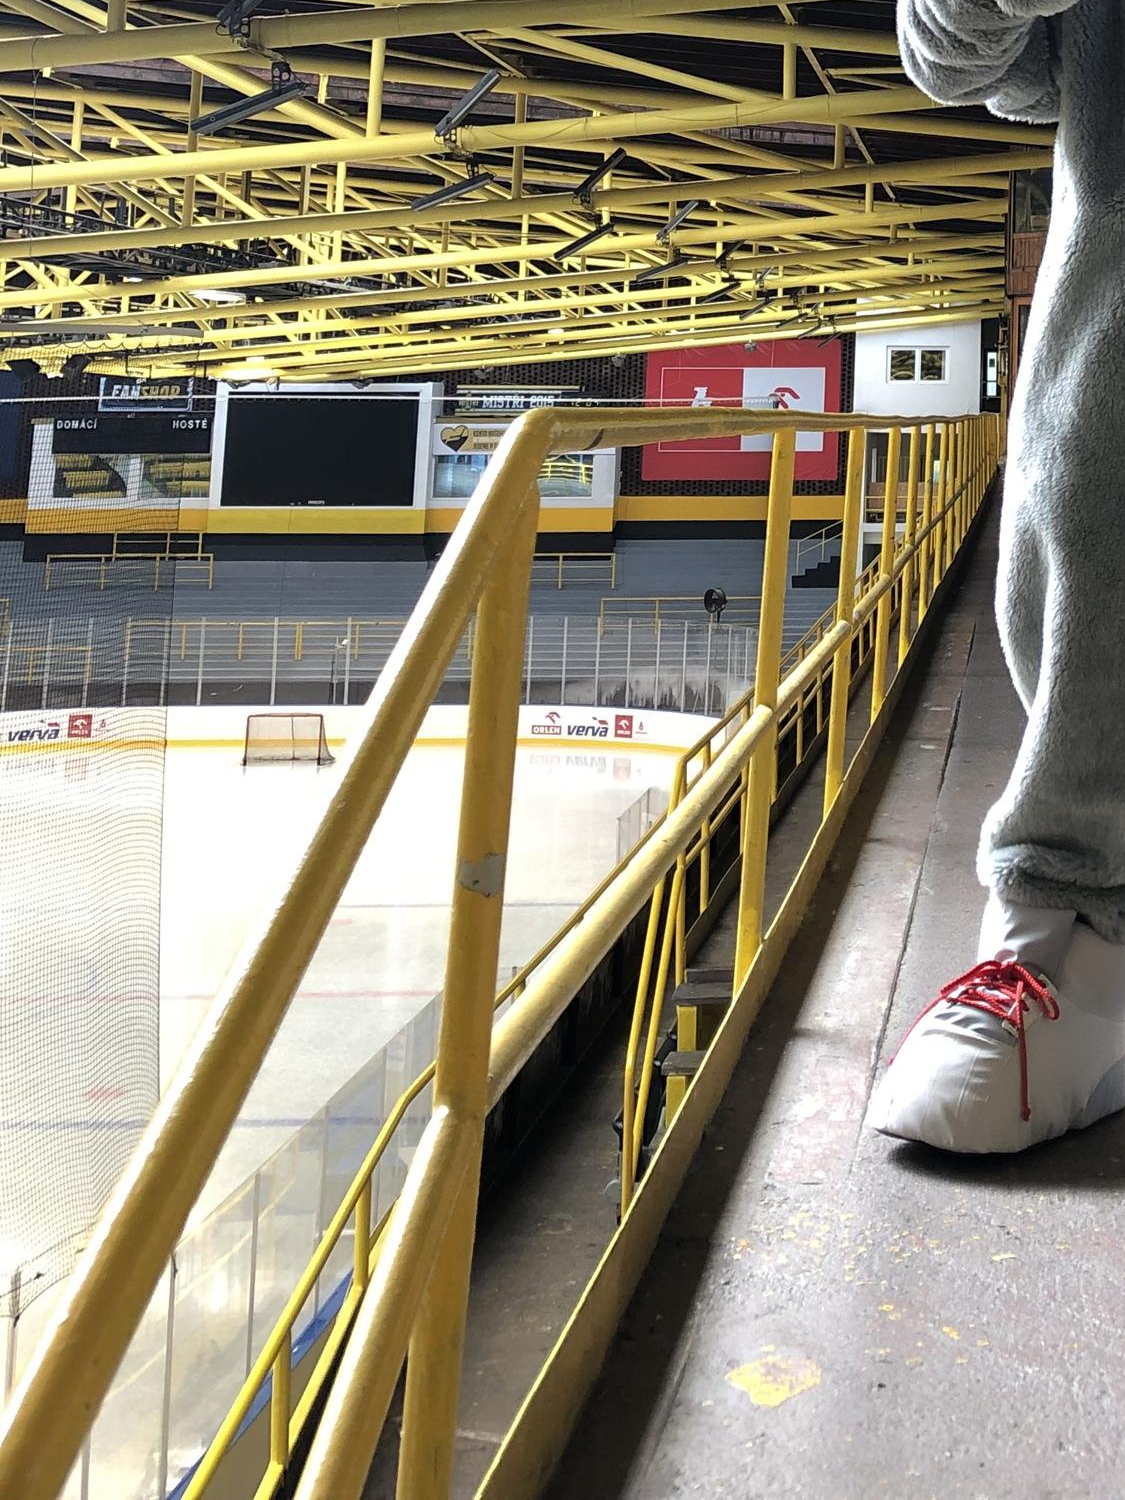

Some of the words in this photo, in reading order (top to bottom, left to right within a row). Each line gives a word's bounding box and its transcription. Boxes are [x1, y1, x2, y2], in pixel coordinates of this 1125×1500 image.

[56, 418, 98, 430] DOMÁCÍ
[172, 418, 208, 430] HOSTÉ
[8, 729, 60, 742] verva
[567, 725, 609, 737] verva
